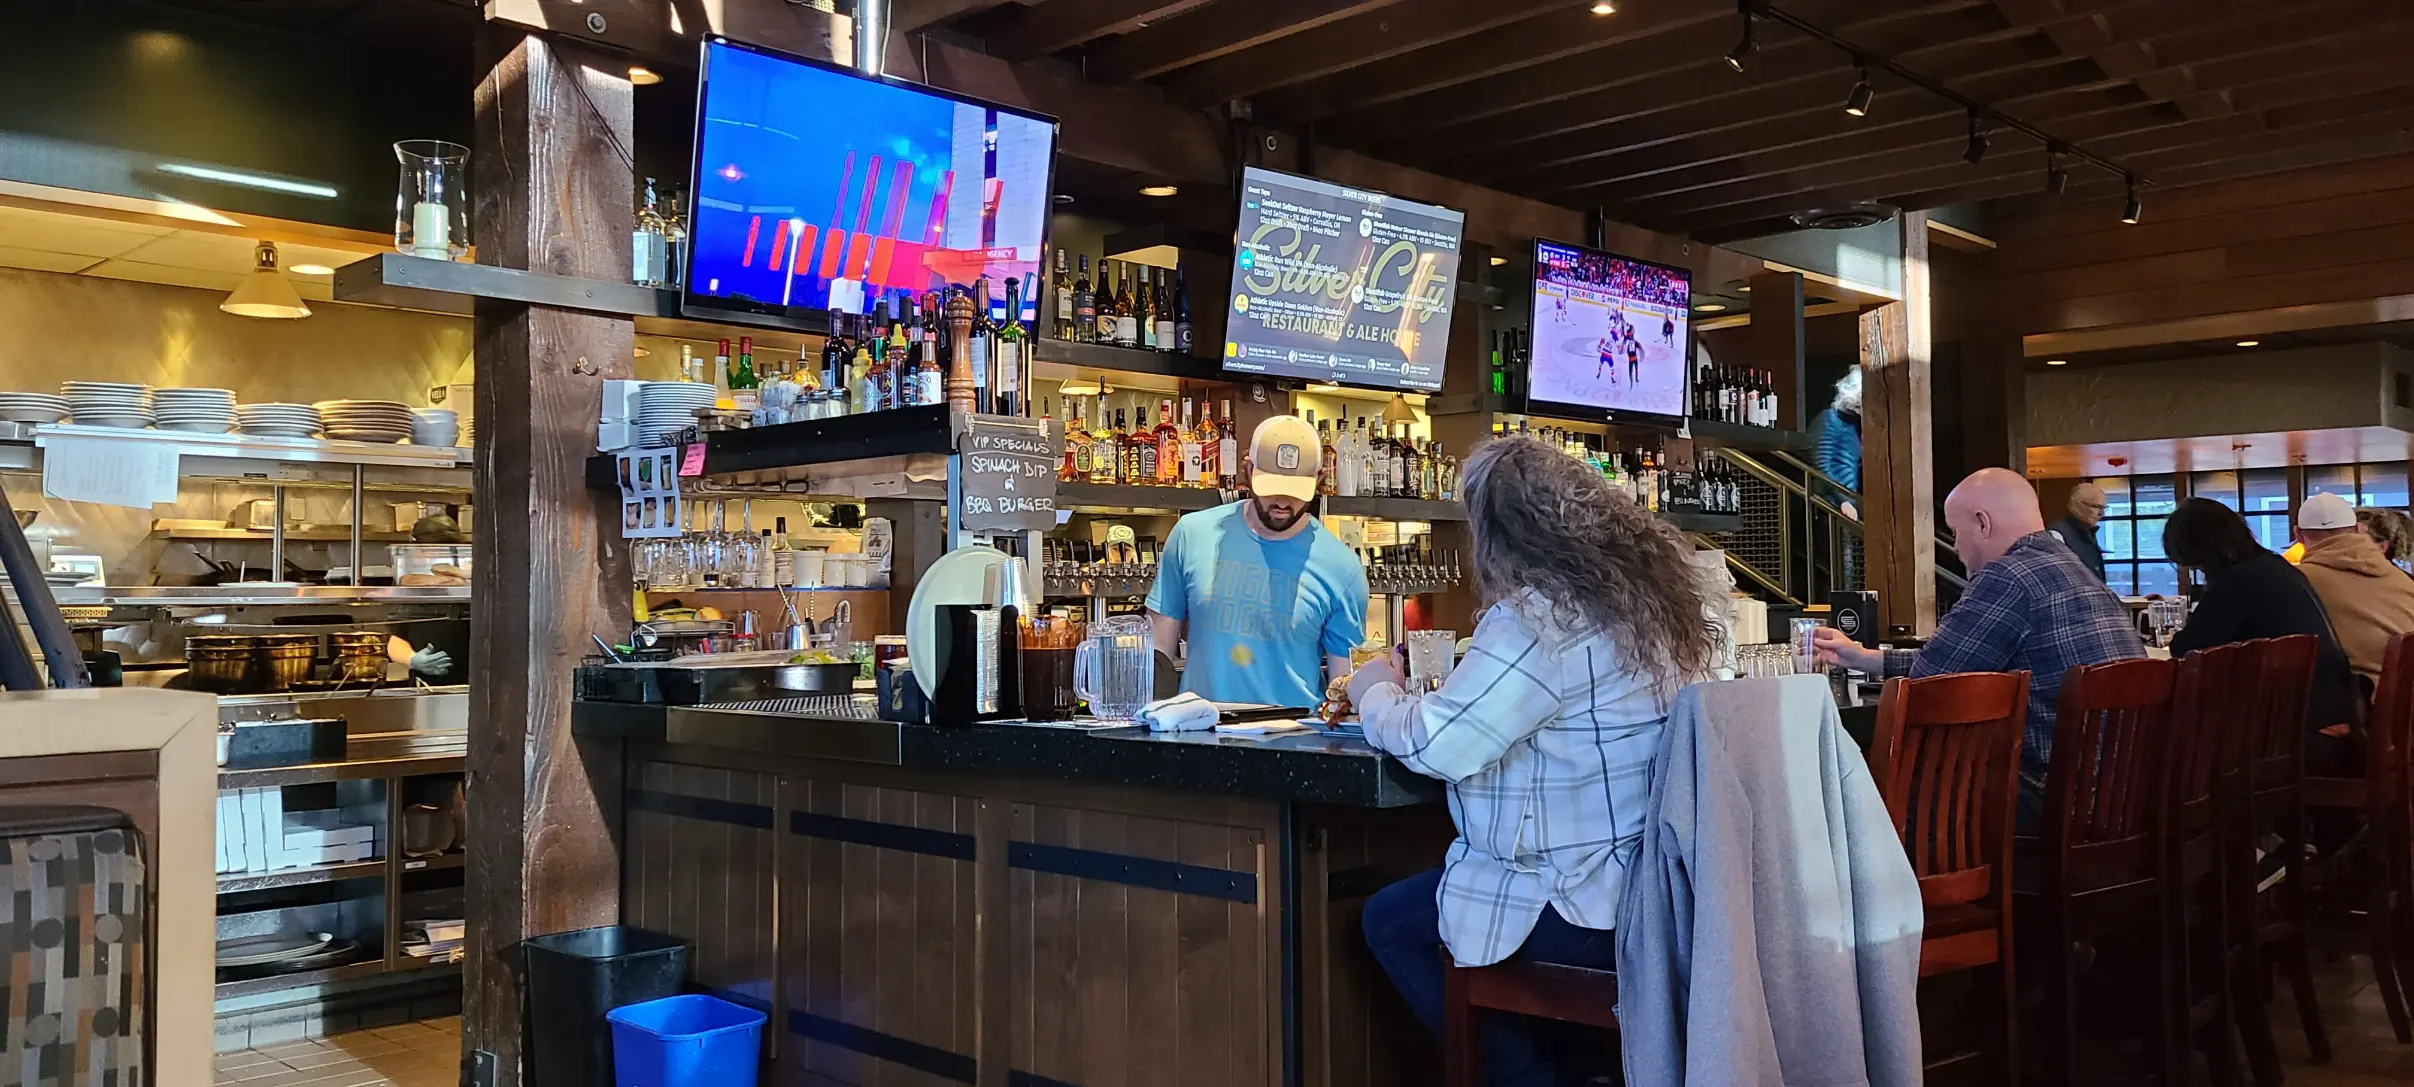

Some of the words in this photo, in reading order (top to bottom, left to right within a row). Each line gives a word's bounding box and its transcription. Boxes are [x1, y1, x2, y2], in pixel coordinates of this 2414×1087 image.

[1358, 192, 1367, 201] CITY
[1261, 208, 1272, 216] Hard
[1273, 210, 1290, 219] Seltzer
[1300, 215, 1310, 223] ABV
[1282, 203, 1298, 212] Seltzer
[1299, 205, 1321, 217] Raspberry
[1322, 212, 1336, 221] Meyer
[1336, 215, 1352, 223] Lemon
[1271, 218, 1283, 227] Draft
[1298, 223, 1310, 232] Draft
[1324, 228, 1341, 237] Pitcher
[1255, 253, 1274, 263] Athletic
[1274, 256, 1284, 265] Run
[1284, 258, 1295, 266] Wild
[1303, 261, 1339, 274] (Non-Alcoholic)
[1570, 288, 1595, 300] DISCOVER
[1249, 296, 1269, 305] Athletic
[1268, 298, 1284, 309] Upside
[1296, 302, 1313, 312] Golden
[1262, 314, 1345, 338] RESTAURANT
[1346, 323, 1354, 339] &
[1355, 324, 1378, 342] ALE
[1380, 328, 1422, 347] HOE
[972, 436, 990, 449] VIP
[992, 437, 1050, 454] SPECIALS
[971, 456, 1021, 474] SPINACH
[1023, 461, 1048, 479] DIP
[966, 496, 993, 515] BBQ
[997, 497, 1055, 514] BURGER
